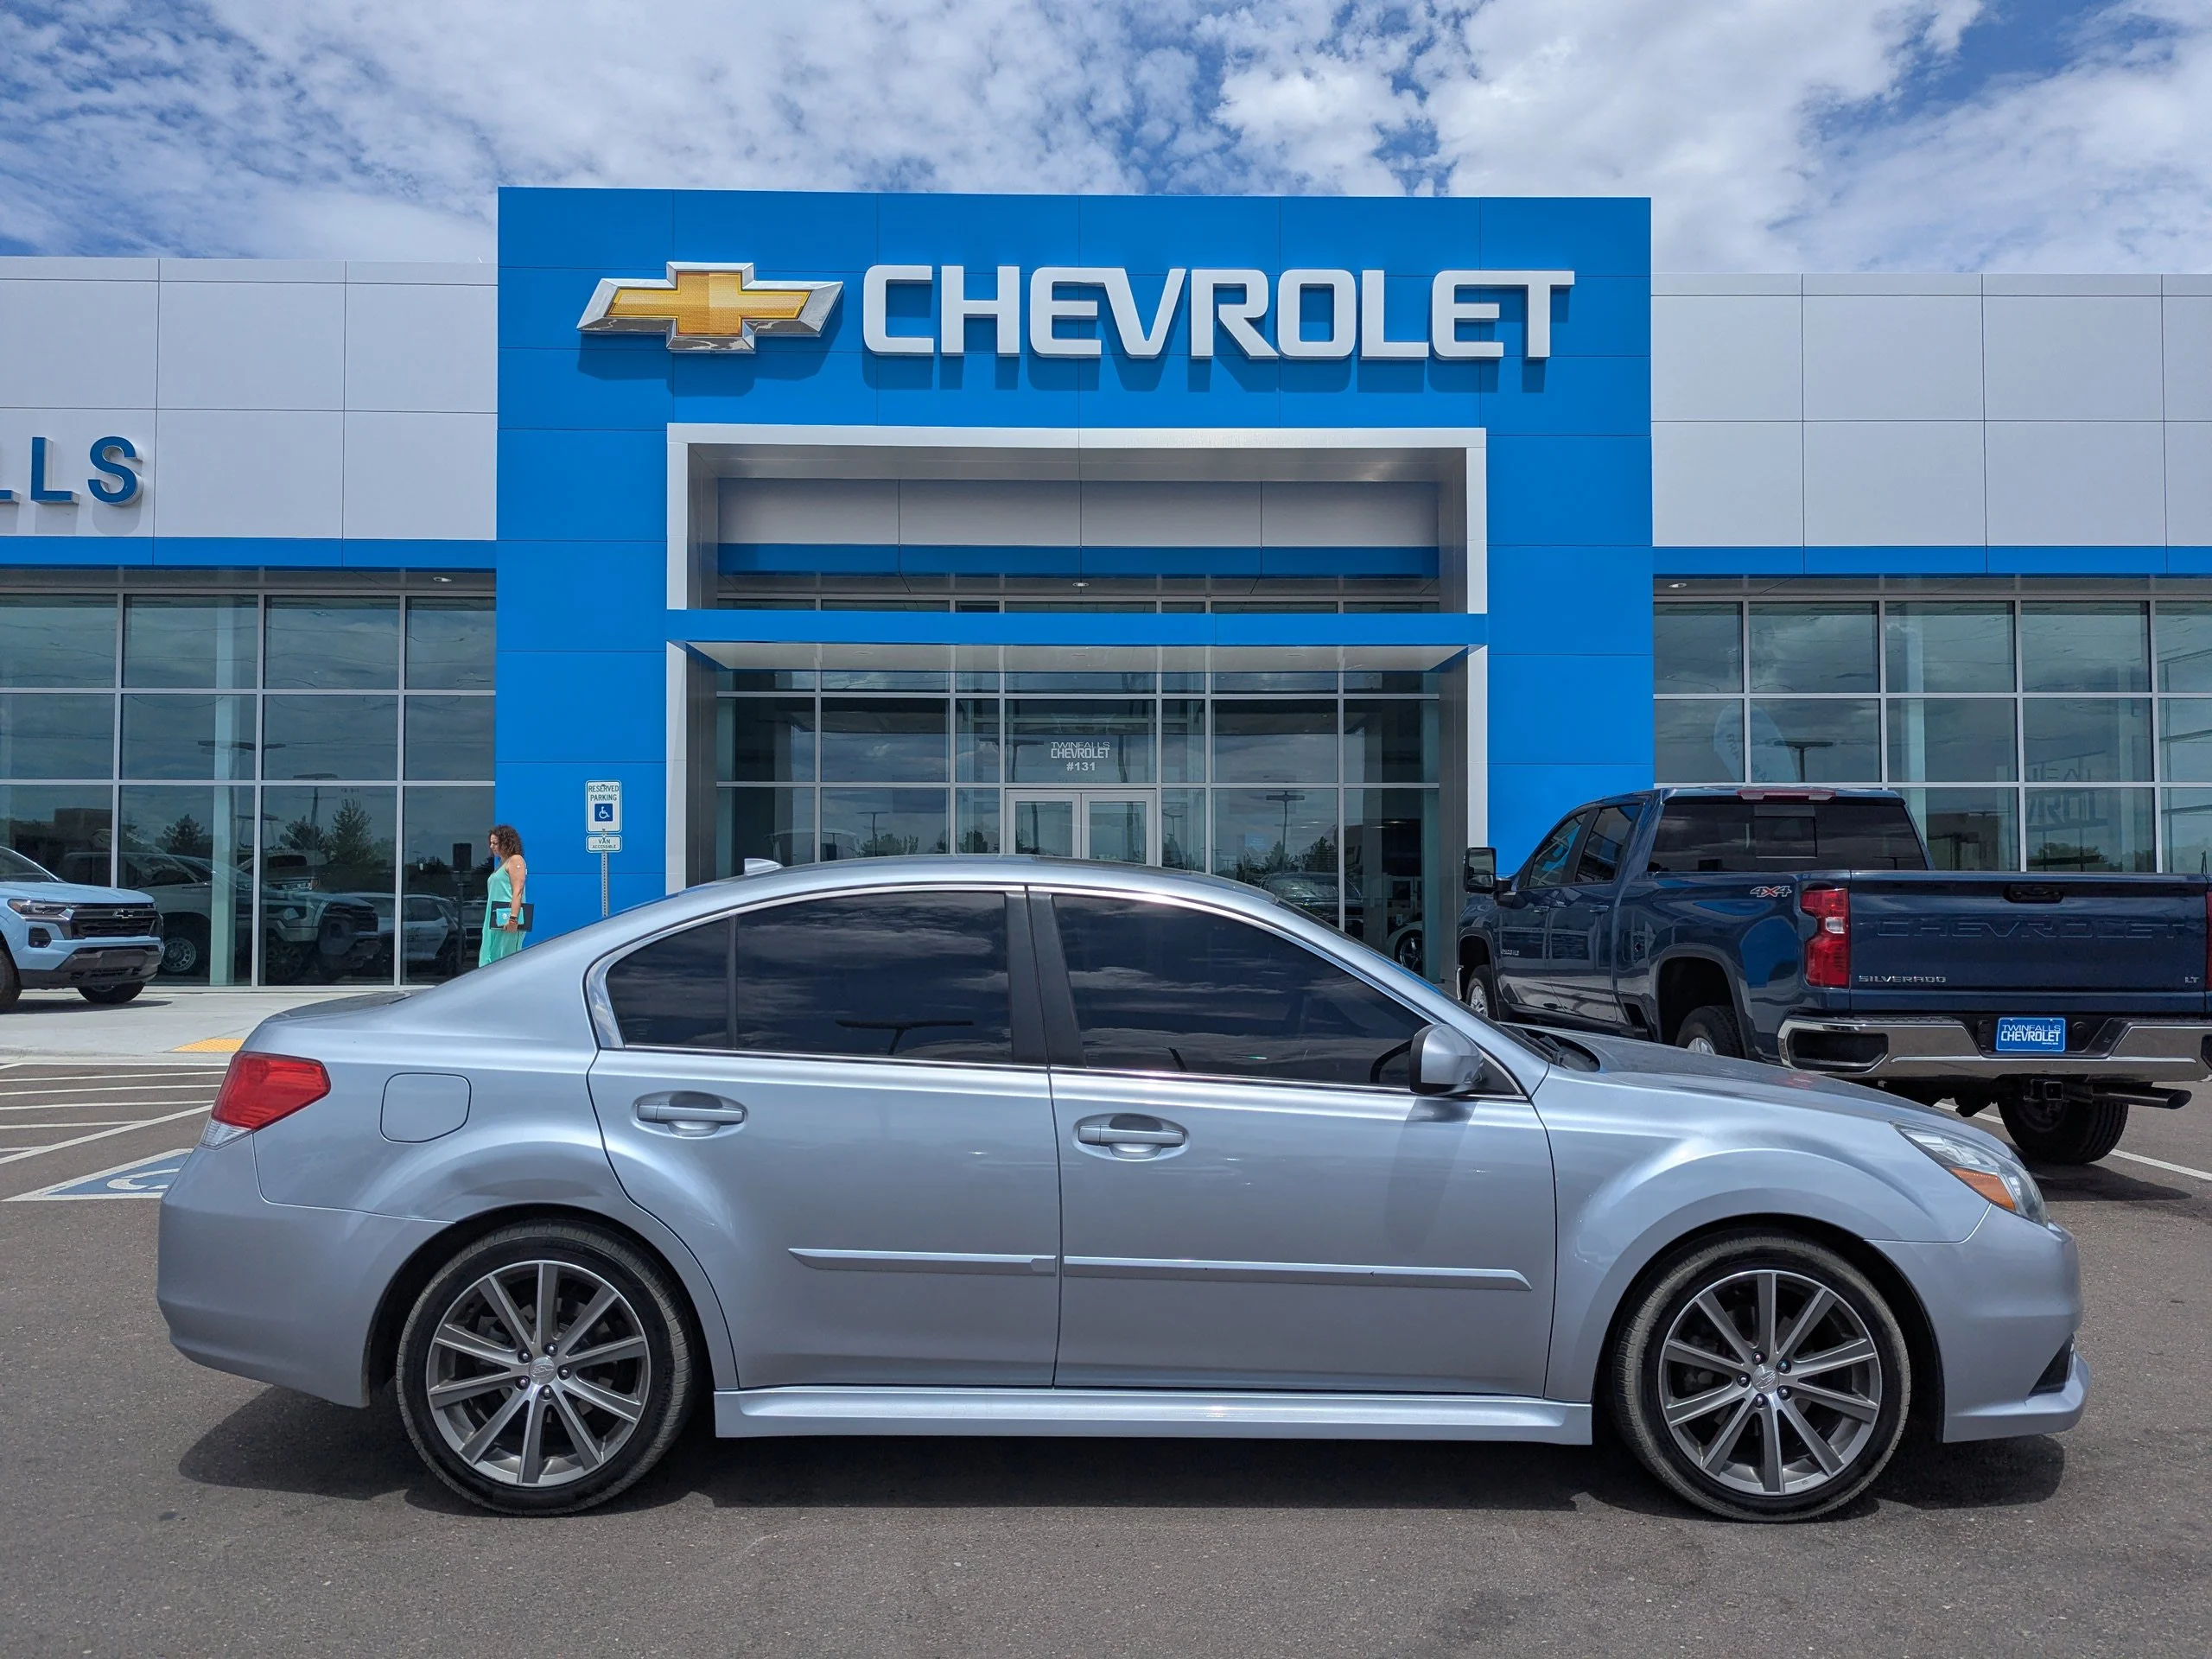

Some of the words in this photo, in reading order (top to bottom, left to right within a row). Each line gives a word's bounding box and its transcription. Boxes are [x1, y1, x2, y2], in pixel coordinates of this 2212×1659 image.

[863, 264, 1575, 359] CHEVROLET
[0, 435, 144, 505] LS
[1051, 748, 1110, 759] CHEVROLET
[1066, 762, 1096, 771] #131
[1877, 921, 2185, 939] CHEVROLET
[1859, 975, 1947, 983] SILVERADO
[2001, 1031, 2061, 1041] CHEVROLET
